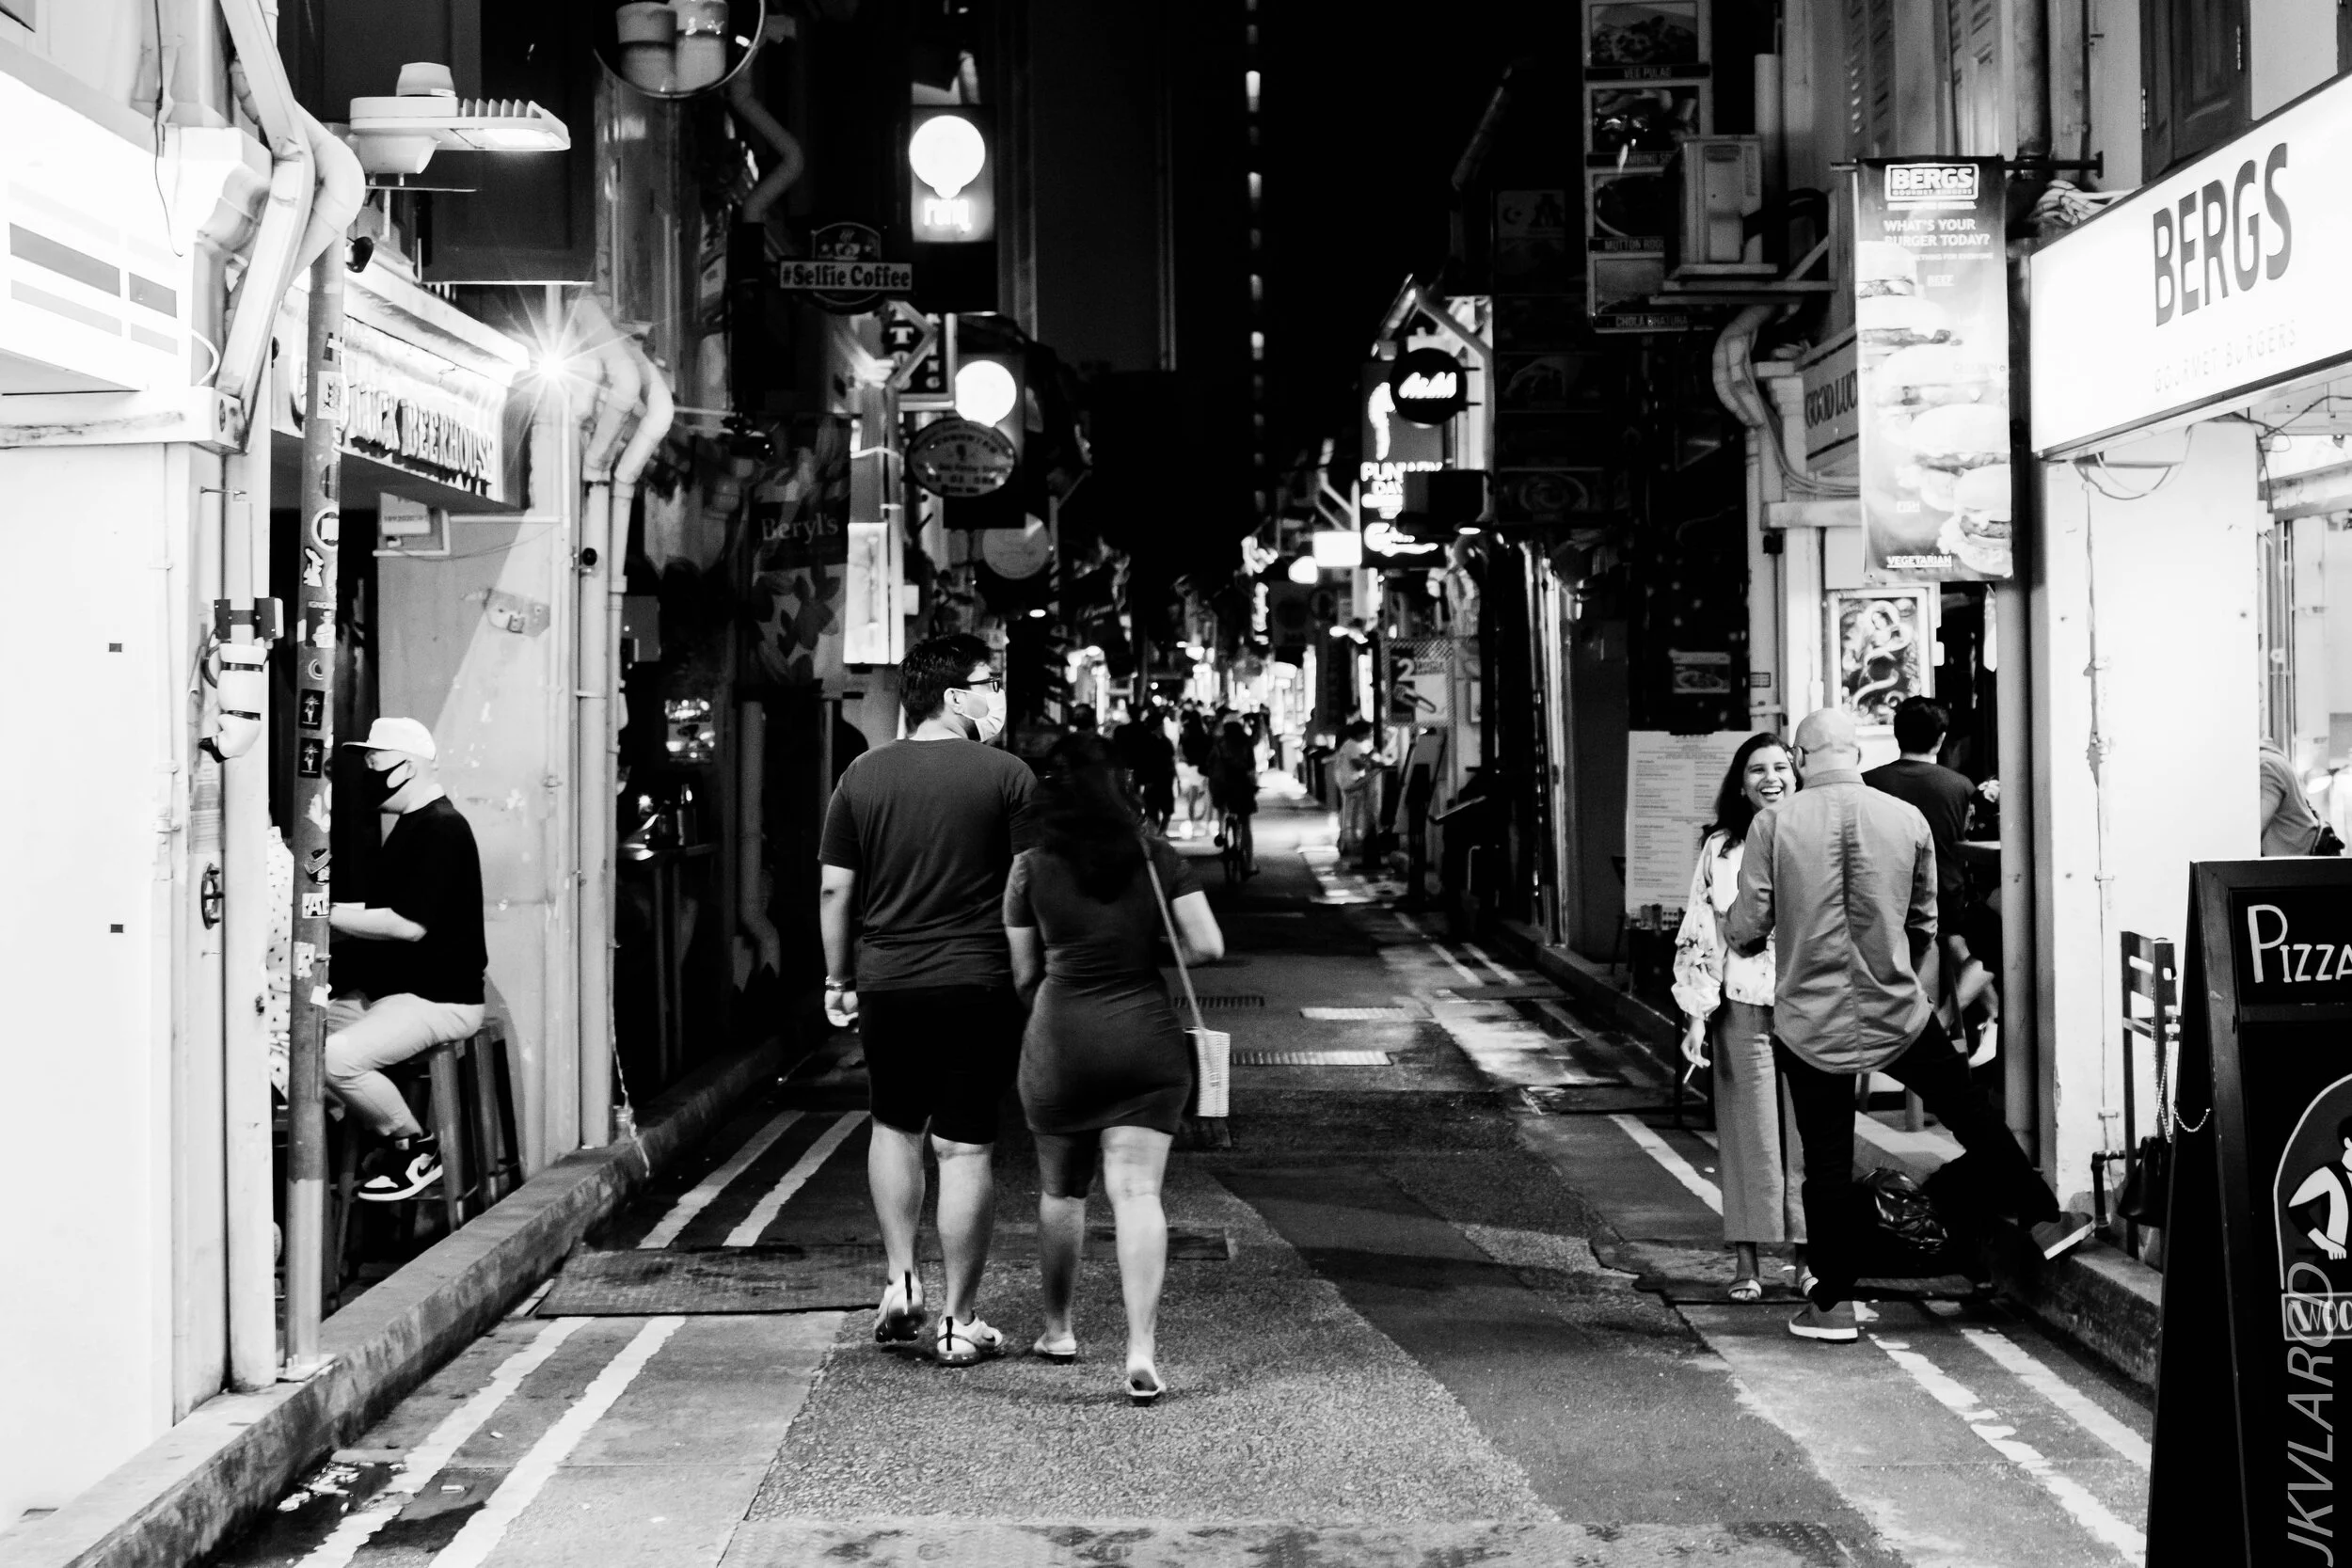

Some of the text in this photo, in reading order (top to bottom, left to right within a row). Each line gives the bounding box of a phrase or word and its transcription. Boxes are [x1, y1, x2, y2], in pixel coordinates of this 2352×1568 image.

[1891, 167, 1974, 190] BERGS
[1883, 218, 1977, 231] WHAT'S YOUR
[2153, 143, 2292, 326] BERGS
[1884, 233, 1990, 246] BURGER TODAY?
[783, 264, 910, 287] #Selfie Coffee
[2225, 318, 2296, 369] BURGERS
[1805, 368, 1858, 429] GOOD LUC
[1886, 555, 1952, 568] VEGETARIAN
